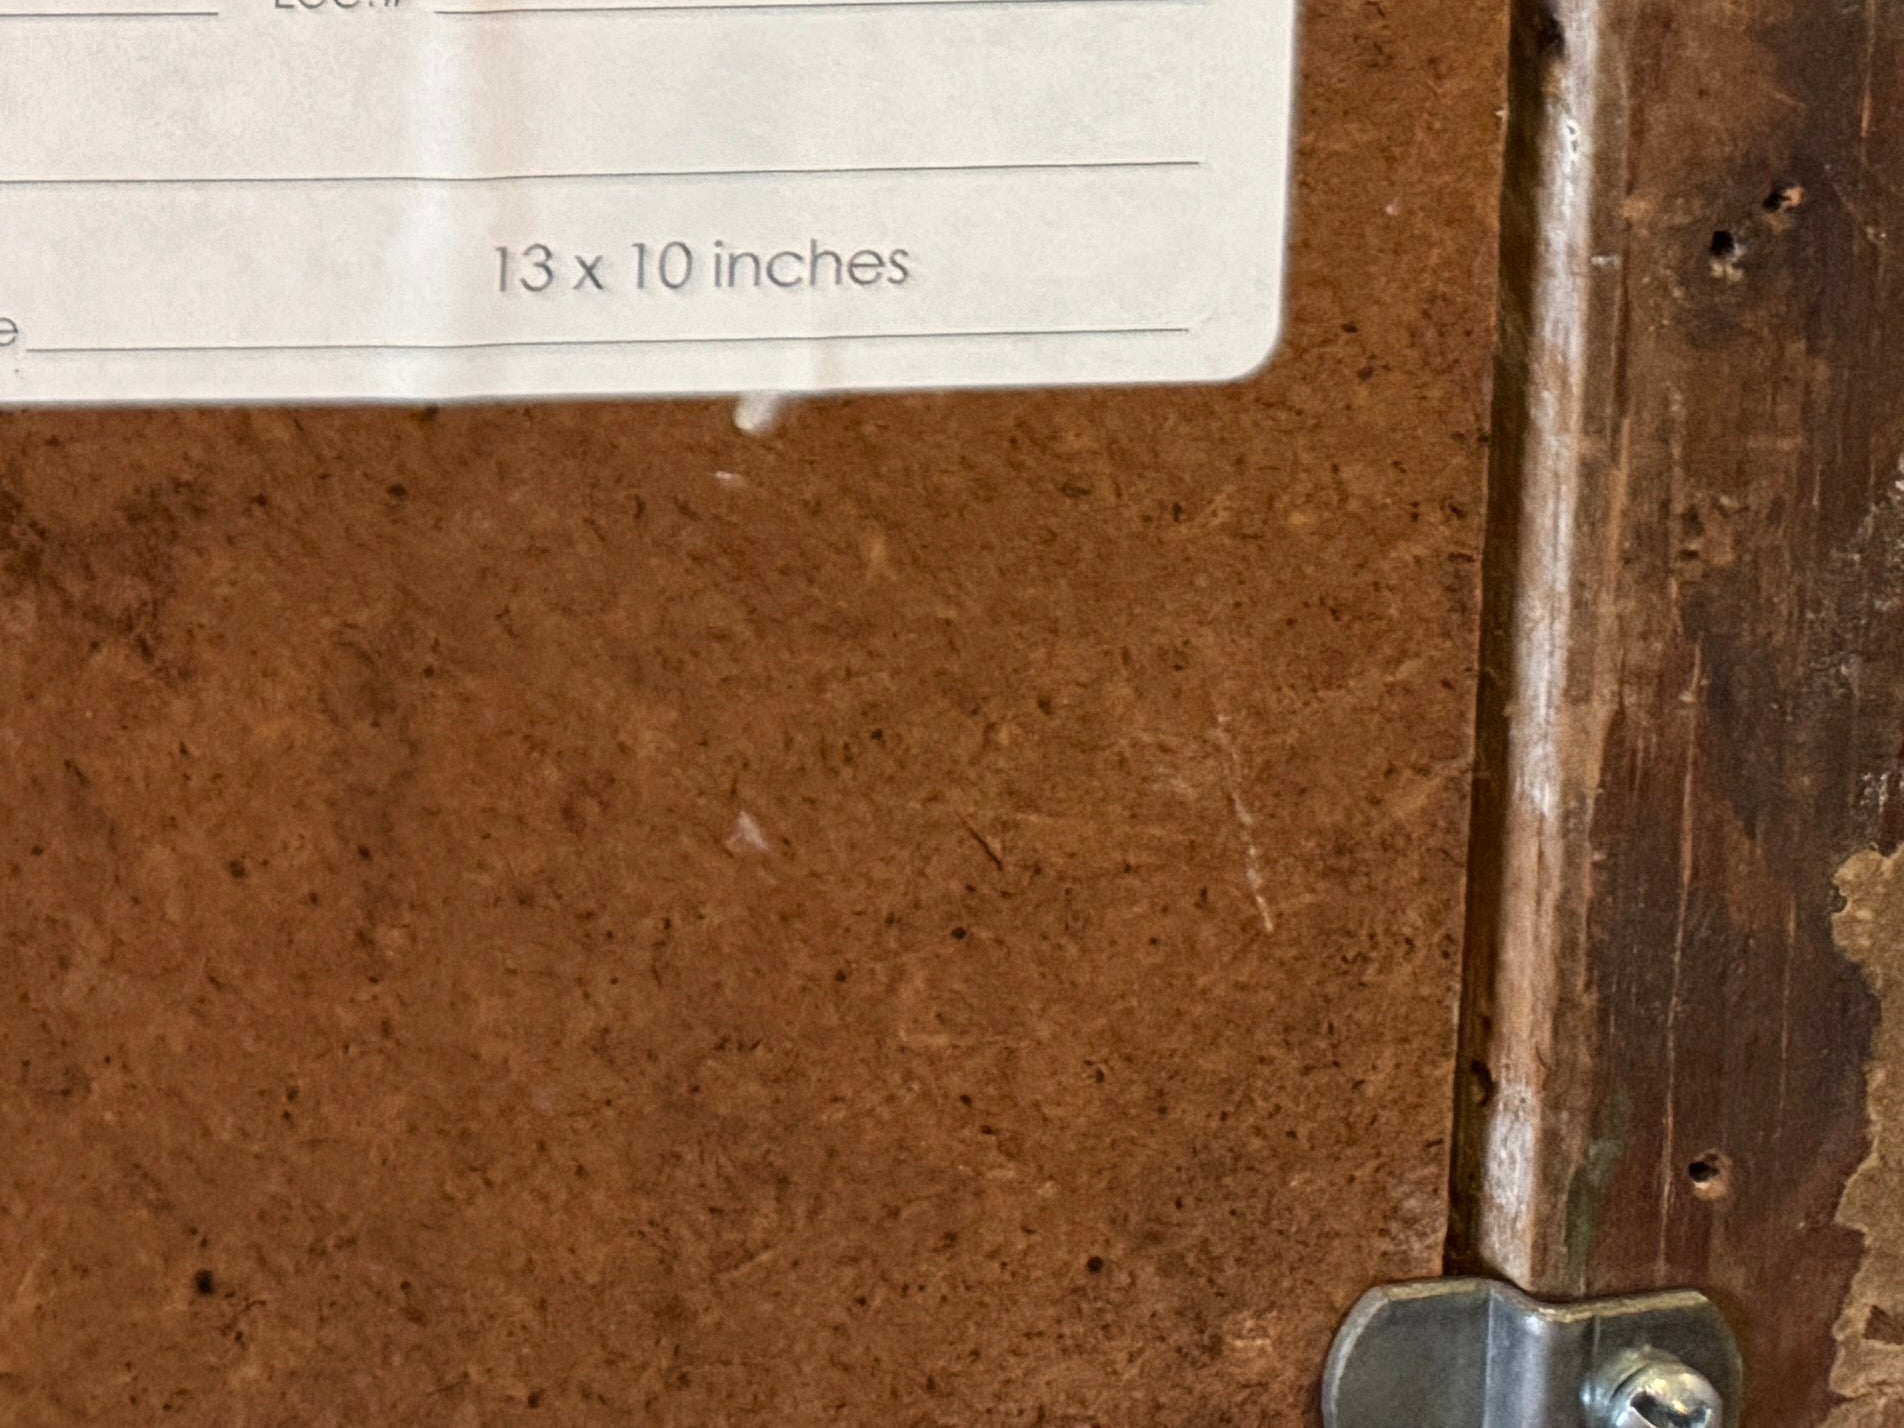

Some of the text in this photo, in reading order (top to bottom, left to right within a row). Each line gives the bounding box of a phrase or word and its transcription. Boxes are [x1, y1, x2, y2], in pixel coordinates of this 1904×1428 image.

[495, 242, 556, 294] 13
[573, 255, 606, 292] x
[631, 240, 695, 292] 10
[713, 238, 912, 290] inches
